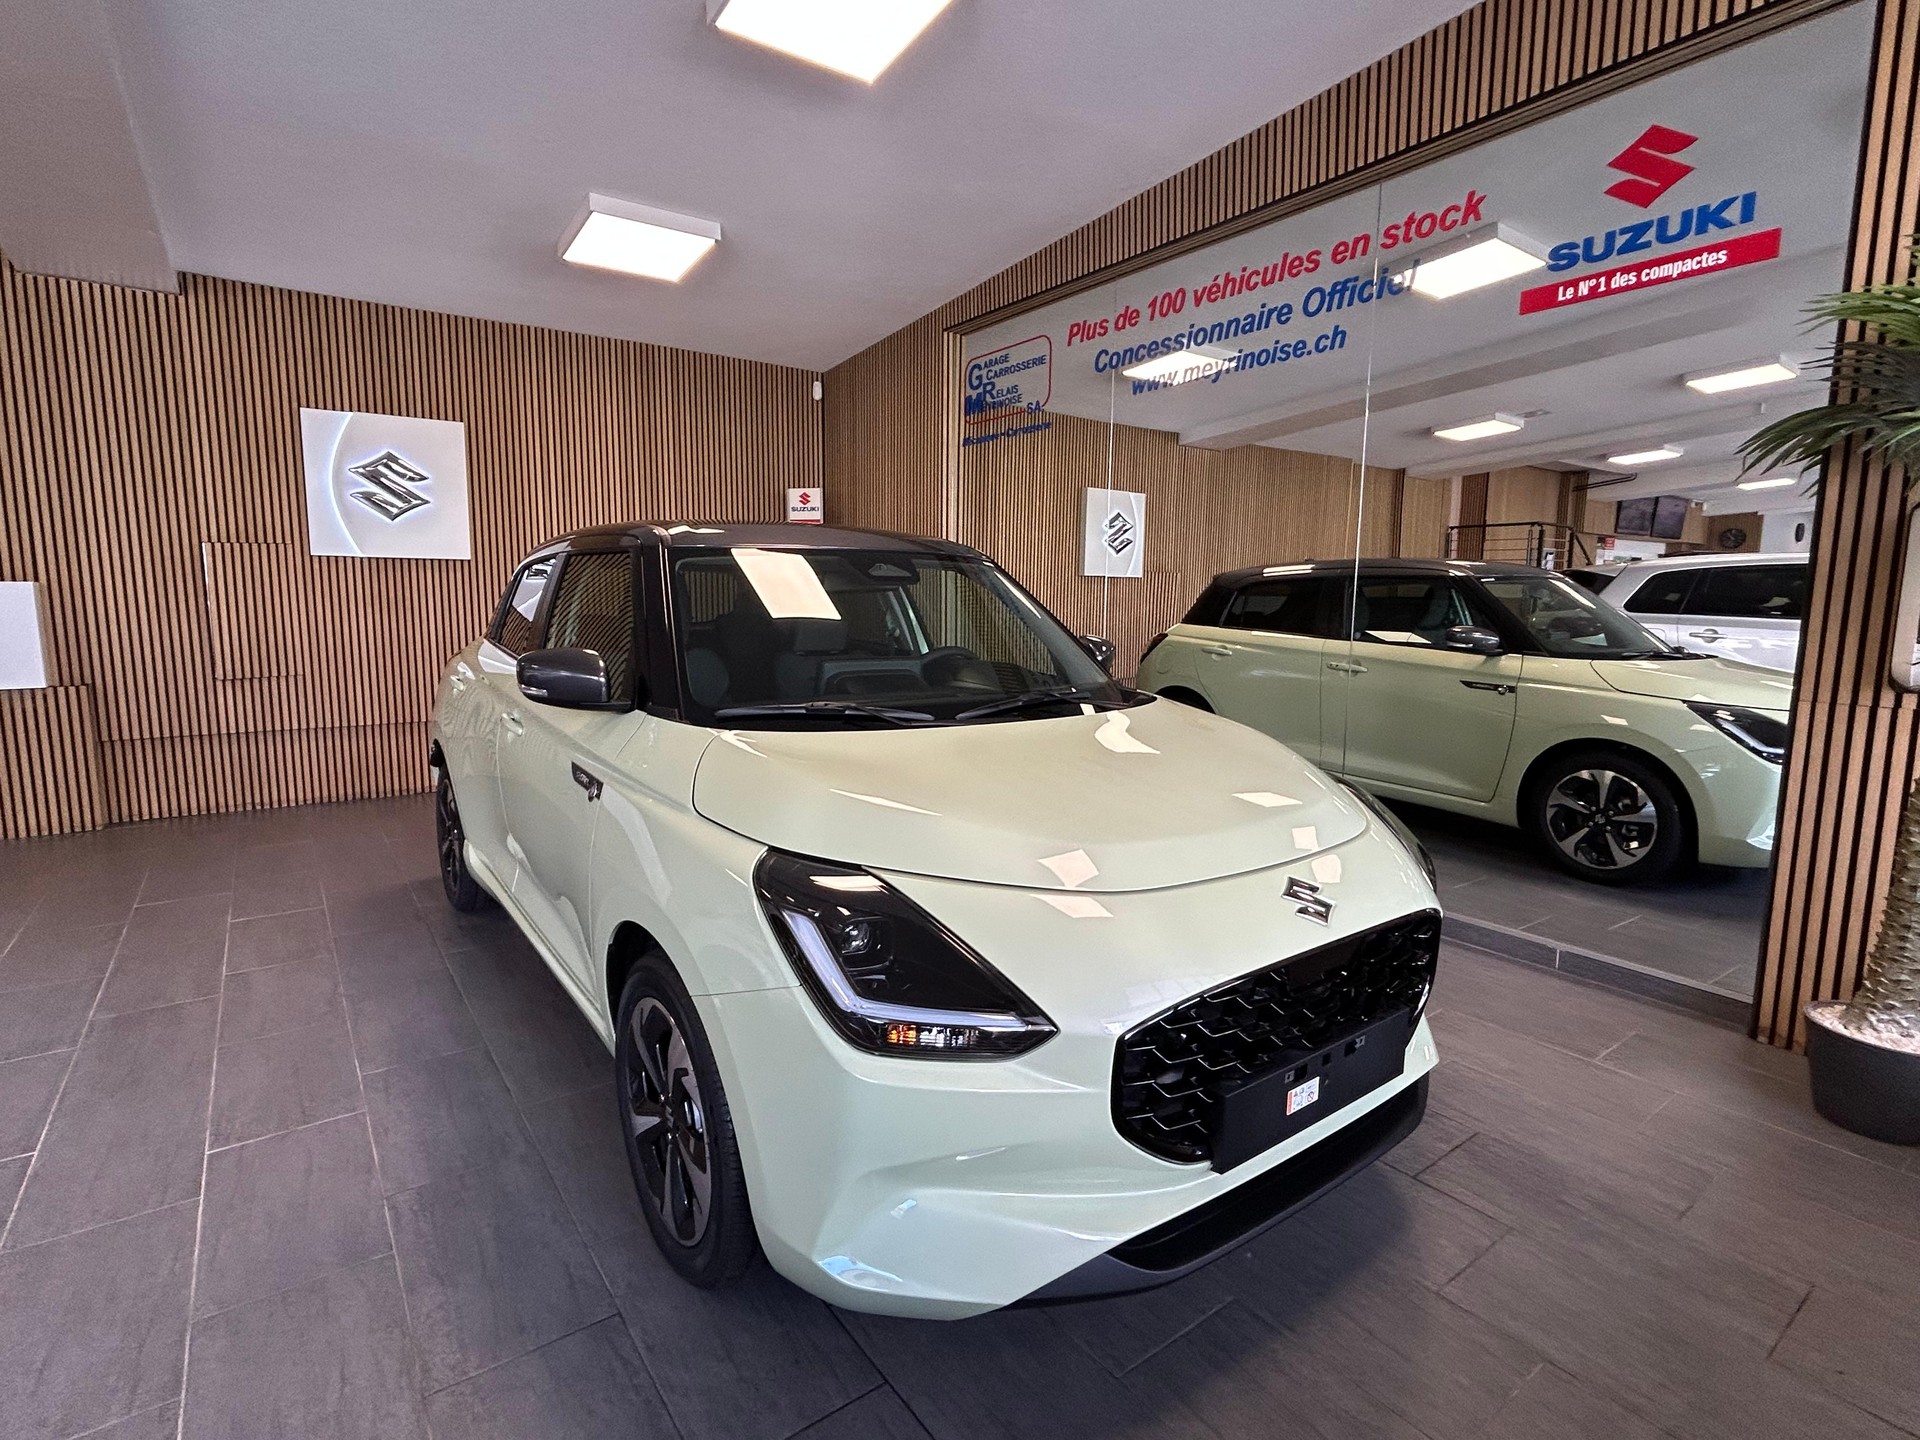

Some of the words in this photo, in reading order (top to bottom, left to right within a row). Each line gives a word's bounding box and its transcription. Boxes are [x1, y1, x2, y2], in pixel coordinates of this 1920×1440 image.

[1546, 190, 1757, 272] SUZUKI
[1066, 319, 1109, 347] Plus
[1114, 305, 1140, 332] de
[1147, 287, 1187, 321] 100
[1193, 251, 1321, 308] véhicules
[1331, 233, 1371, 264] en
[1380, 189, 1487, 249] stock
[1557, 285, 1575, 302] Le
[1610, 271, 1638, 290] des
[1640, 249, 1728, 279] compactes
[985, 354, 1047, 381] CARROSSERIE
[1094, 303, 1293, 373] Concessionnaire
